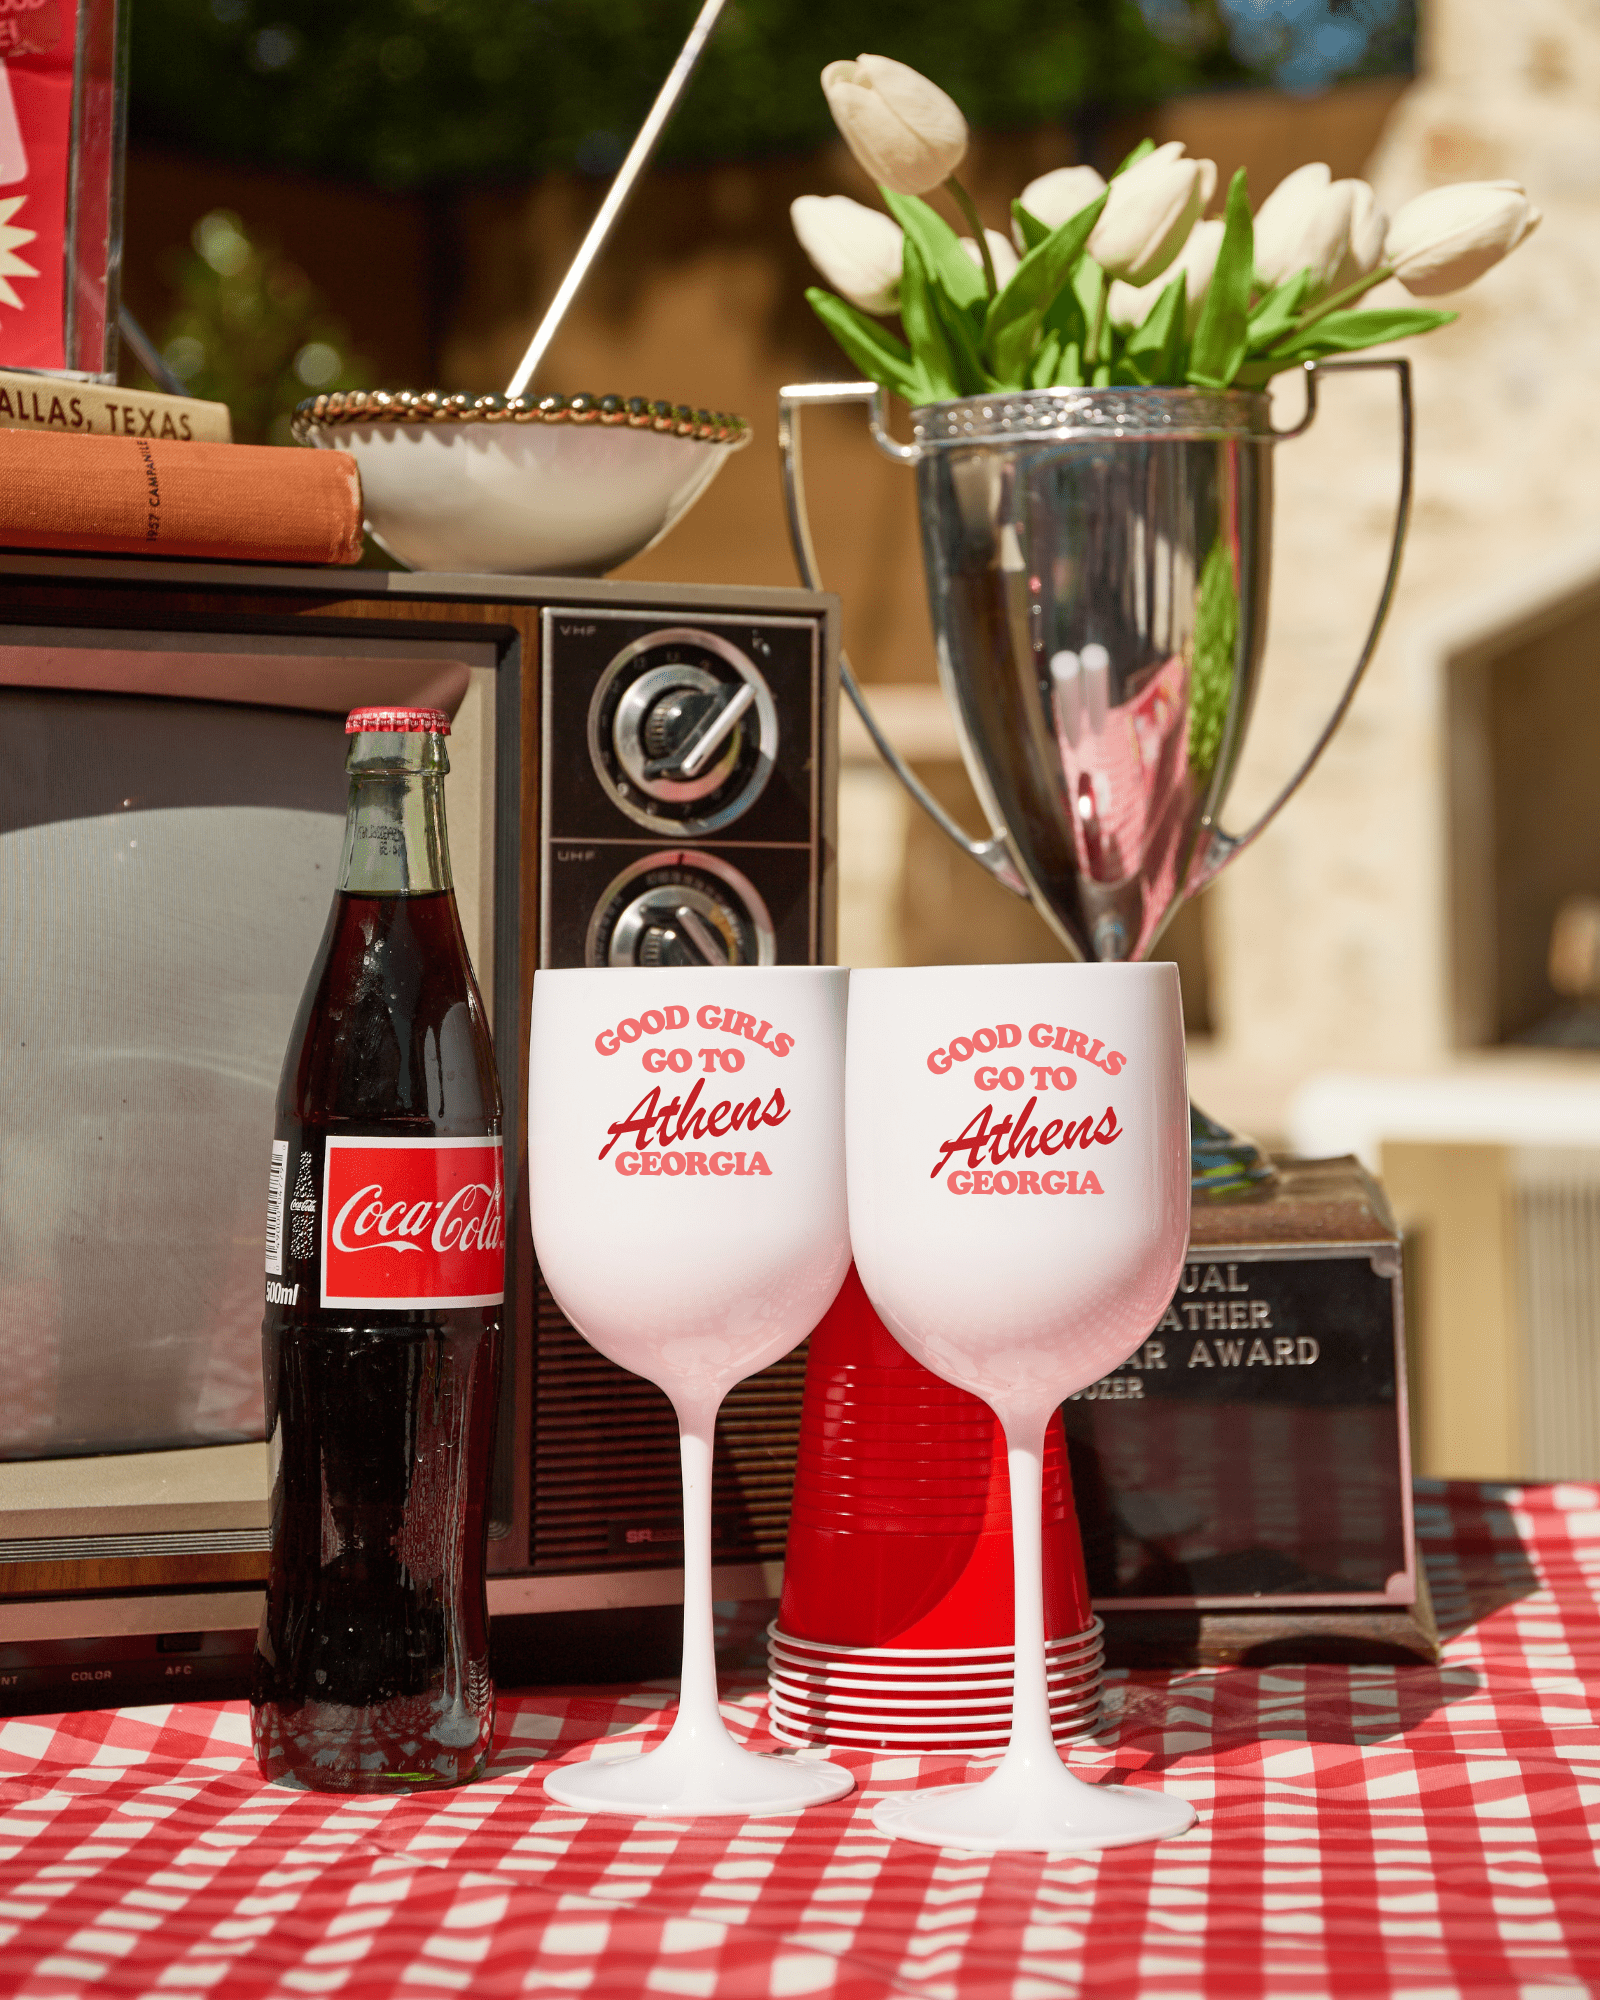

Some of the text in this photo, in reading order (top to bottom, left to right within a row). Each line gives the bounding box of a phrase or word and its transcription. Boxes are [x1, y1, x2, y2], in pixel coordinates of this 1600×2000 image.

[105, 402, 193, 442] TEXAS
[136, 440, 161, 542] 1957 CAMPANILE
[560, 625, 597, 637] VHF
[557, 850, 596, 862] UHF
[595, 1005, 795, 1058] GOOD GIRLS
[641, 1048, 746, 1074] GO TO
[926, 1024, 1128, 1076] GOOD GIRLS
[973, 1066, 1078, 1092] GO TO
[598, 1077, 791, 1161] Athens
[930, 1096, 1123, 1179] Athens
[614, 1151, 773, 1177] GEORGIA
[946, 1170, 1105, 1196] GEORGIA
[332, 1184, 501, 1253] Coca-Cola
[266, 1280, 300, 1306] 500ml
[1187, 1336, 1320, 1368] AWARD
[71, 1671, 113, 1682] COLOR
[165, 1665, 193, 1676] AFC
